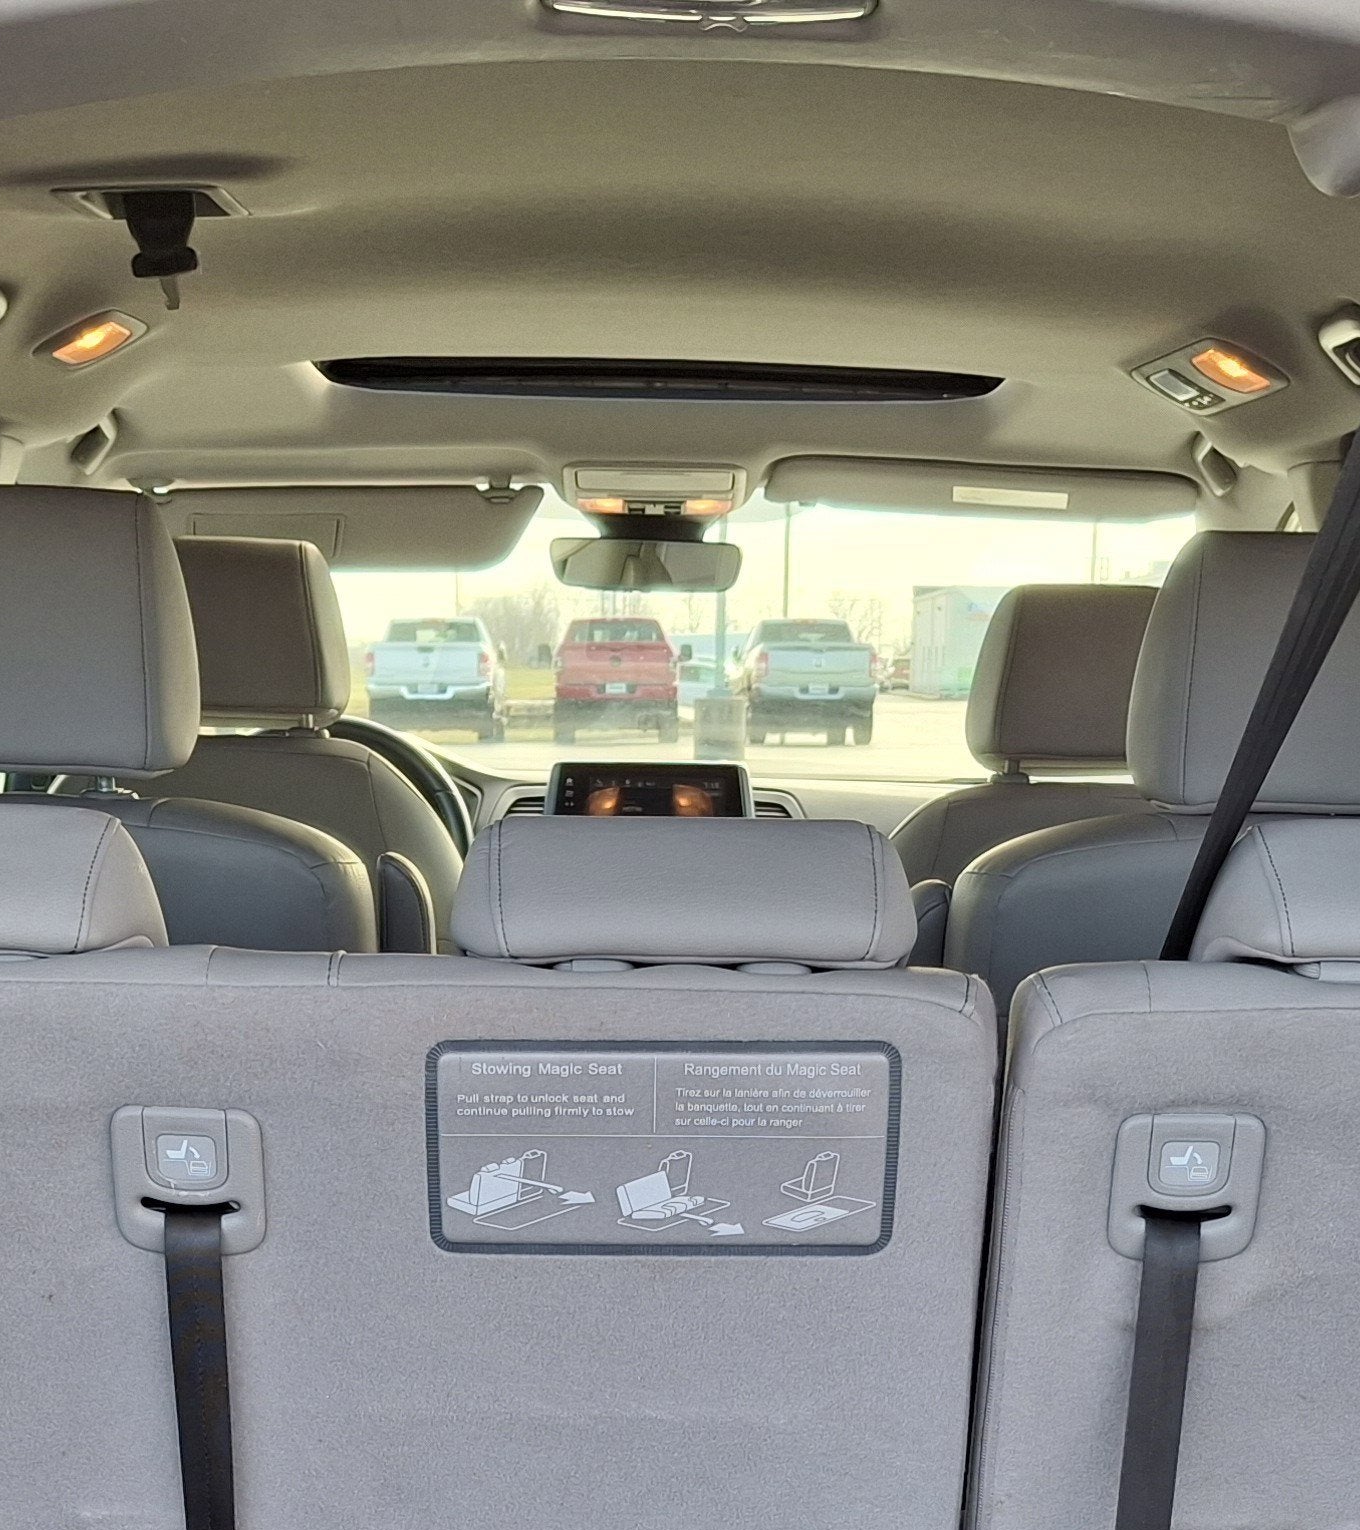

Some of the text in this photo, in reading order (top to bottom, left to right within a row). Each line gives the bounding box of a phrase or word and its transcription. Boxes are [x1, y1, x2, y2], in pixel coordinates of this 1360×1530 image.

[472, 1062, 623, 1078] Stowing Magic Seat
[684, 1063, 861, 1079] Rangement du Magic Seat
[457, 1093, 625, 1106] Pull strap to unlock seat and
[456, 1106, 635, 1118] continue pulling firmly to stow
[674, 1117, 803, 1129] sur celle-ci pour la ranger
